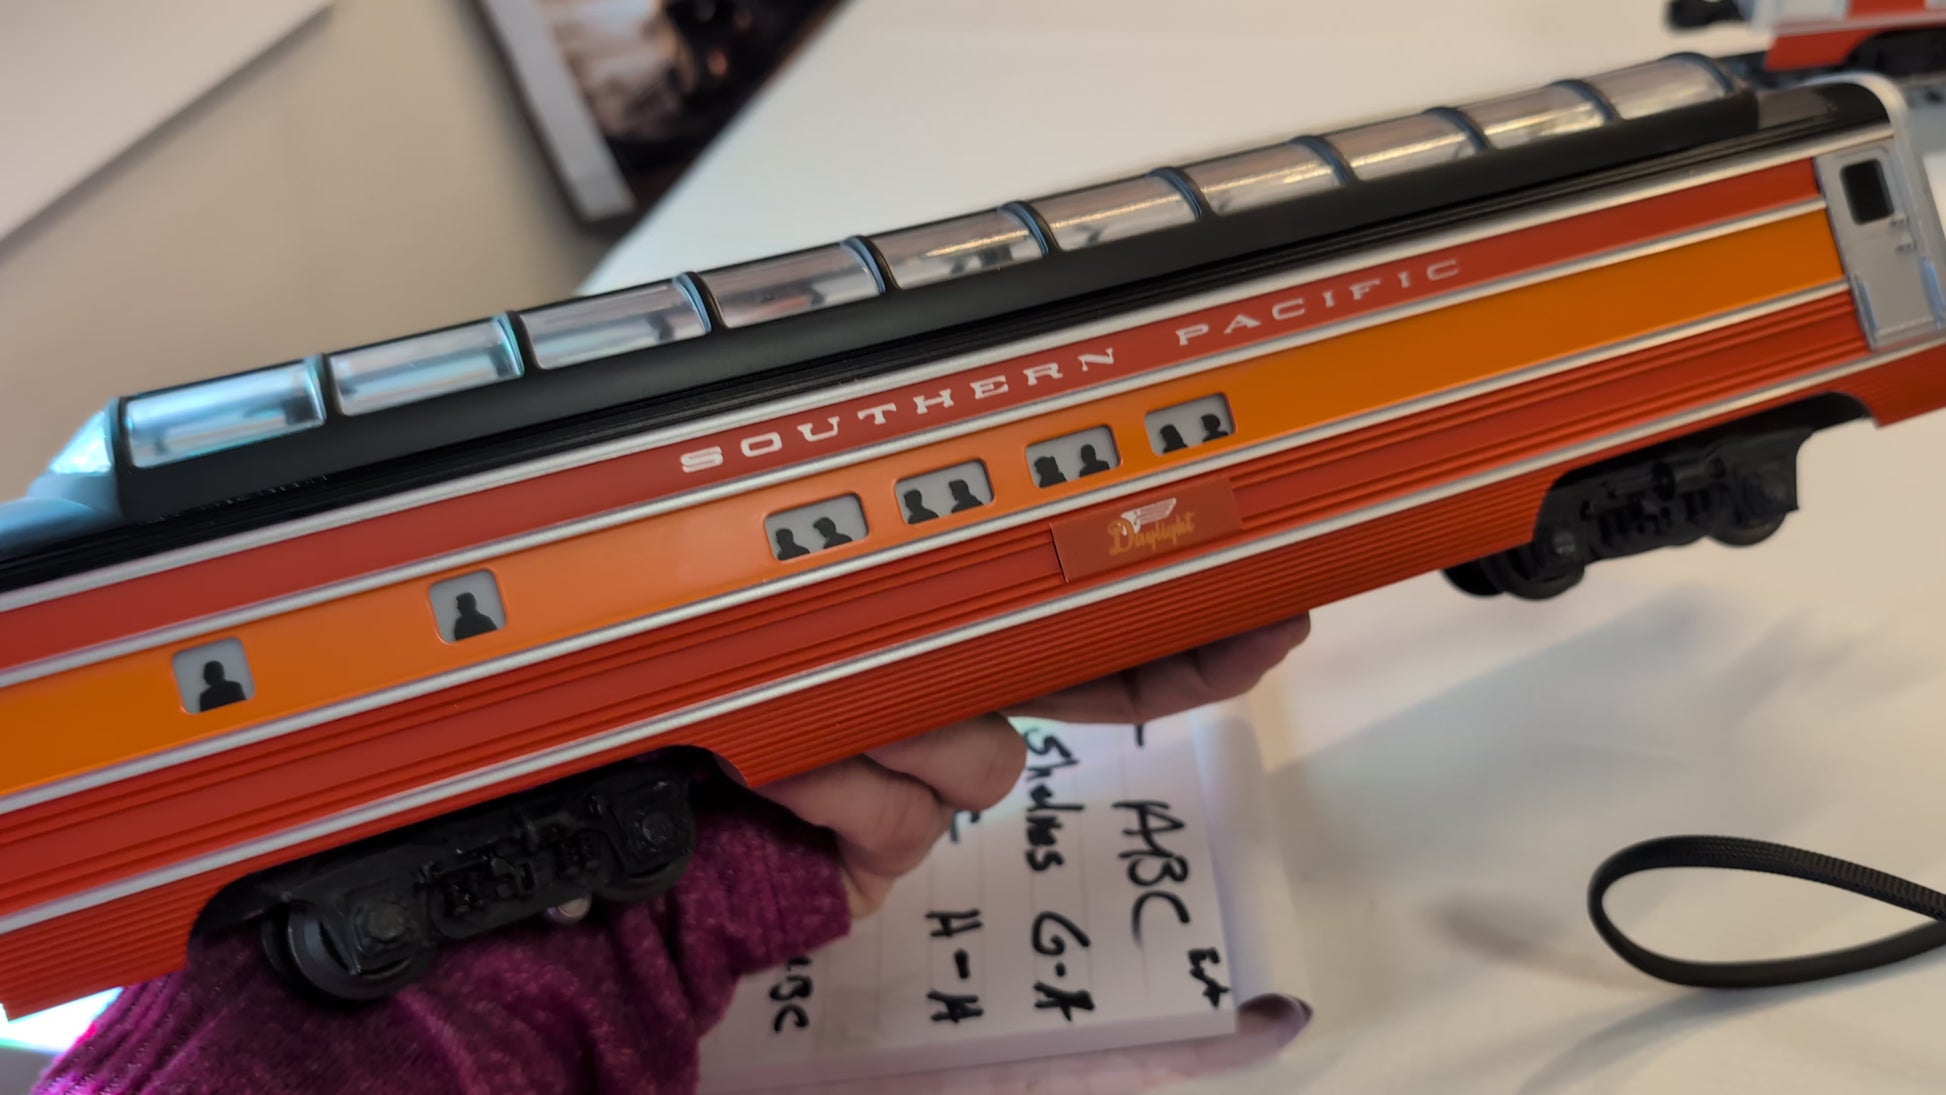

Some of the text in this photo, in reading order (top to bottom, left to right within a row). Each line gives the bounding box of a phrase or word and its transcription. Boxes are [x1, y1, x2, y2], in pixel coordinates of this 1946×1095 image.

[680, 259, 1460, 473] SOUTHERN PACIFIC
[1107, 512, 1196, 556] Daylight
[1112, 800, 1191, 947] ABC
